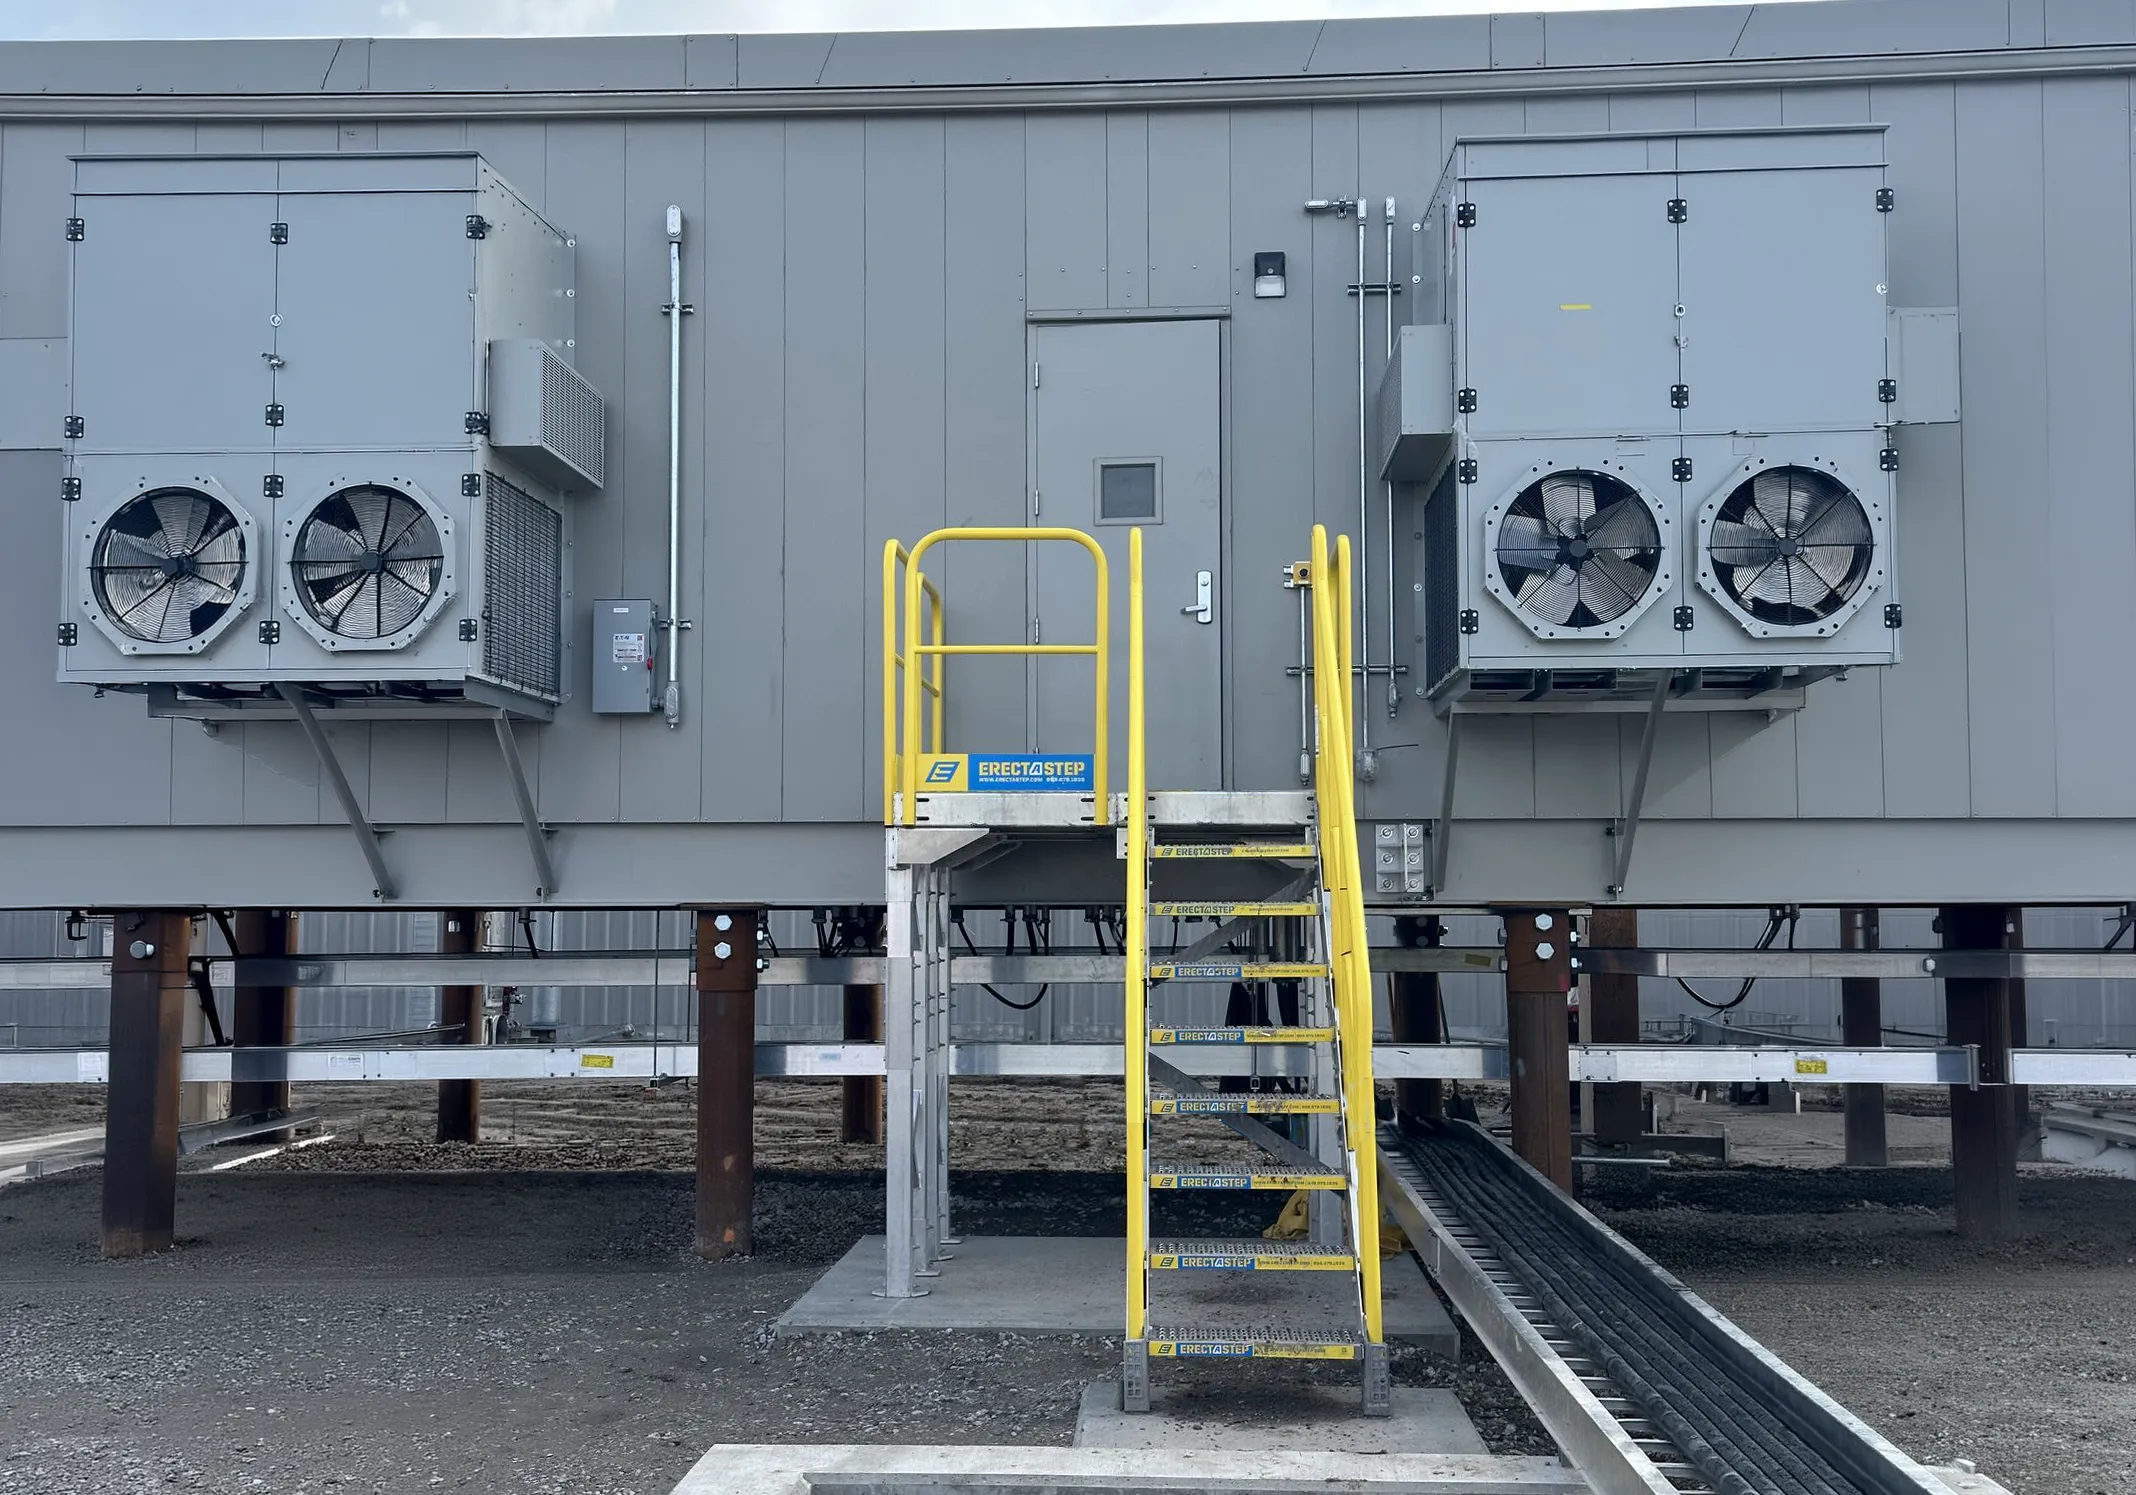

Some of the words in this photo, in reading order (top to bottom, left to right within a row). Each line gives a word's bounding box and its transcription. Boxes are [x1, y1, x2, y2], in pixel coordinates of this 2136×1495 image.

[978, 761, 1086, 776] ERECTASTEP
[1176, 904, 1235, 914] ERECTASTEP
[1179, 1031, 1241, 1041] ERECTASTEP
[1181, 1177, 1248, 1187] ERECTASTEP
[1182, 1257, 1252, 1267] ERECTASTEP
[1180, 1344, 1252, 1354] ERECTASTEP
